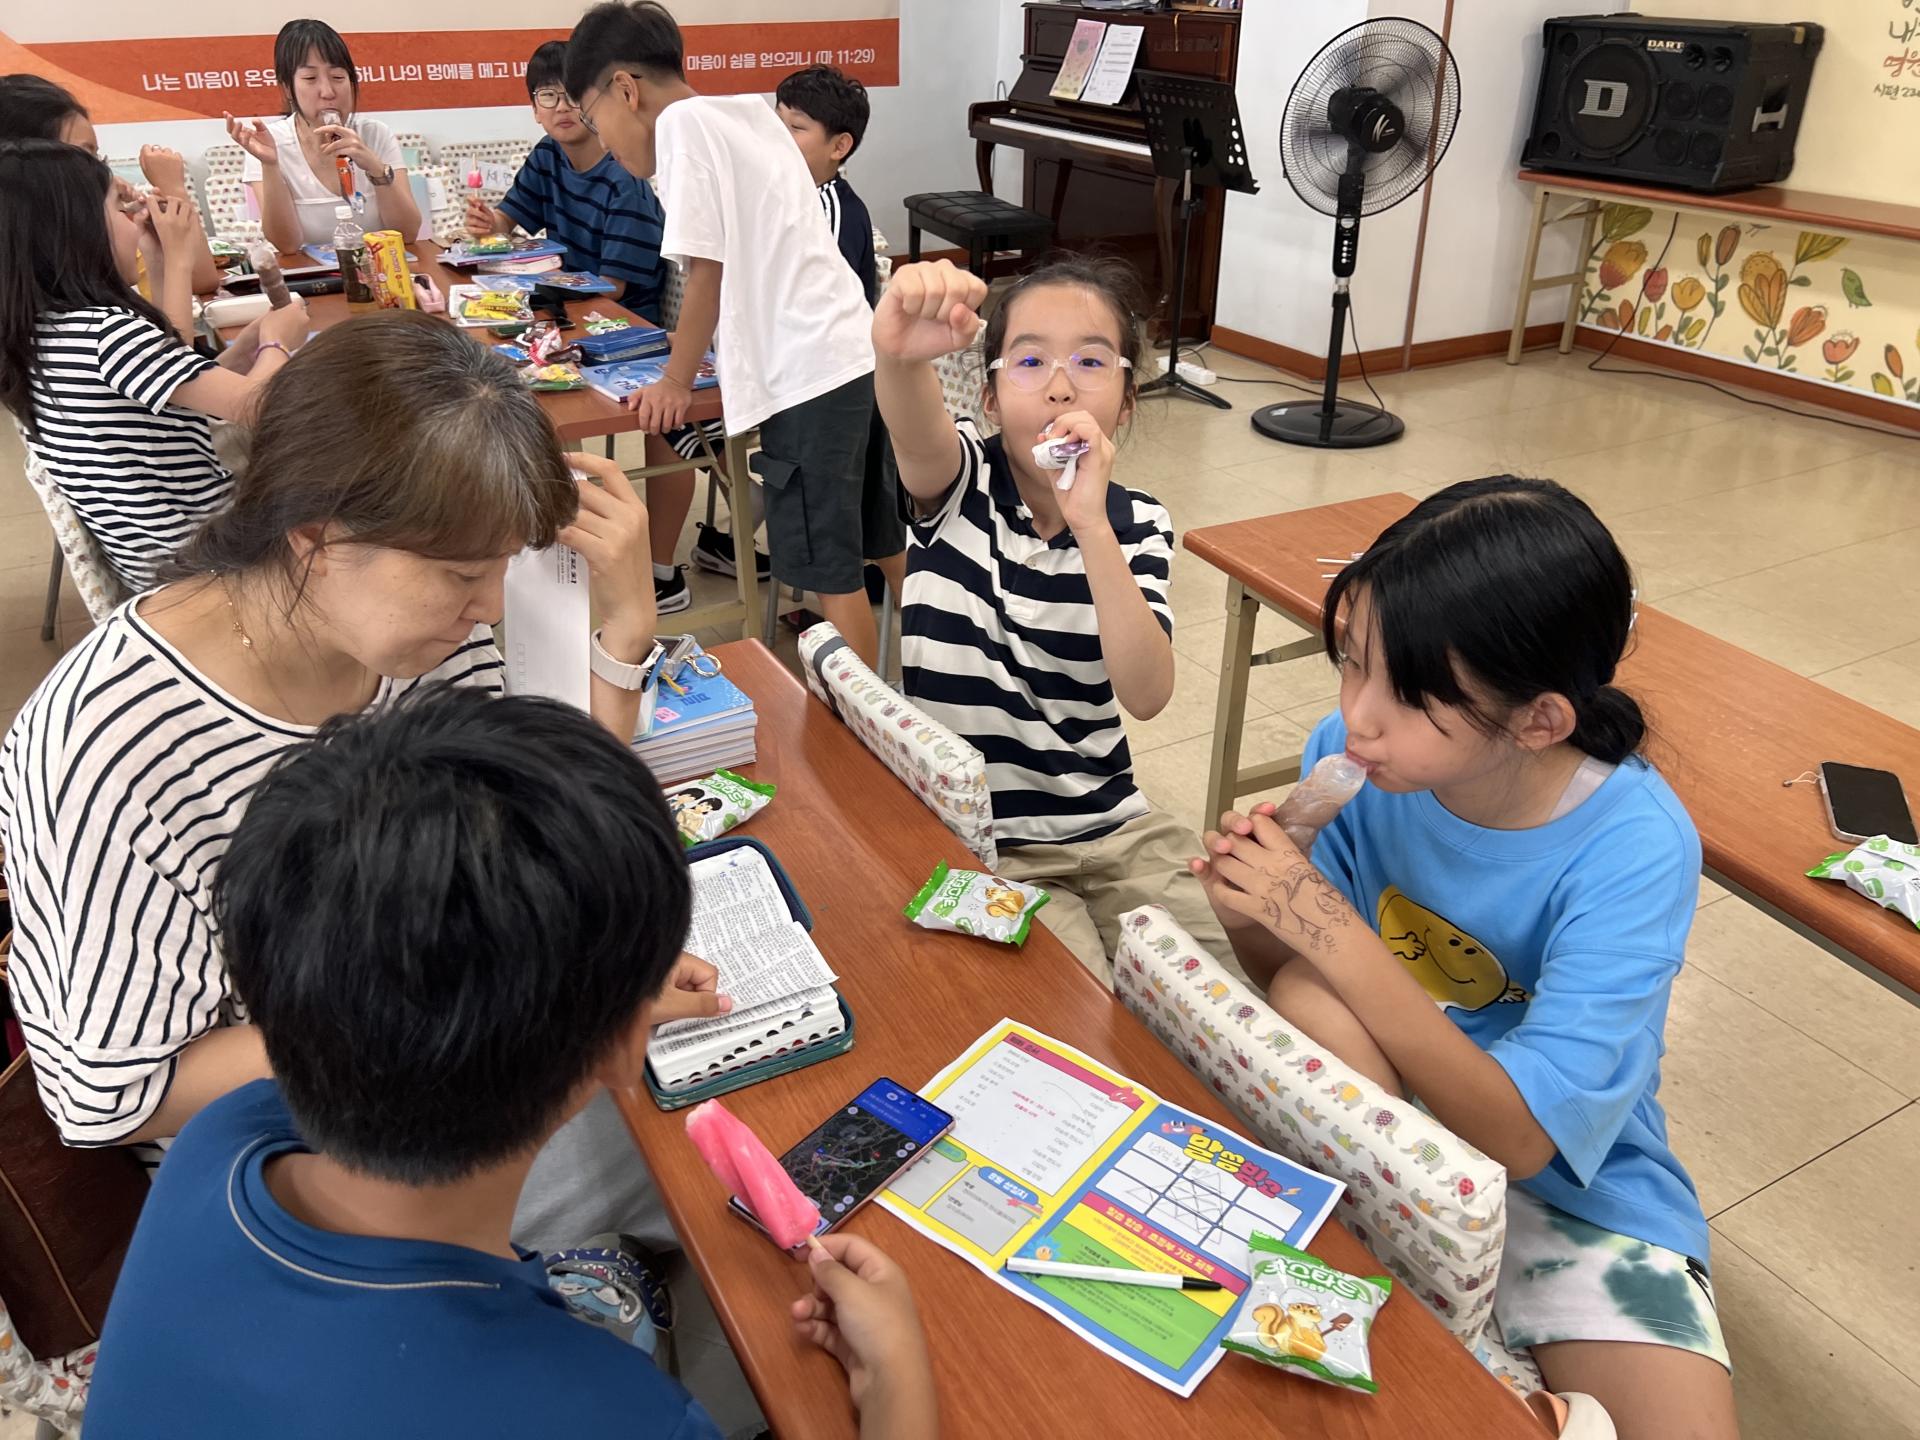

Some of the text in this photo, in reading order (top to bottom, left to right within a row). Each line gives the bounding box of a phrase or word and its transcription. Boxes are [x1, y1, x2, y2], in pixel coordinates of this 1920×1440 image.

[1889, 17, 1920, 43] 내
[1647, 39, 1685, 49] DART
[142, 73, 181, 91] 나는
[184, 70, 240, 90] 마음이
[390, 64, 423, 81] 나의
[426, 63, 474, 81] 멍에를
[478, 62, 509, 79] 메고
[686, 54, 726, 71] 마음이
[730, 53, 757, 69] 쉼을
[760, 51, 811, 68] 얻으리니
[815, 50, 833, 65] (마
[837, 48, 875, 65] 11:29)
[1873, 83, 1900, 101] 시편
[1264, 1257, 1361, 1300] 카스타드
